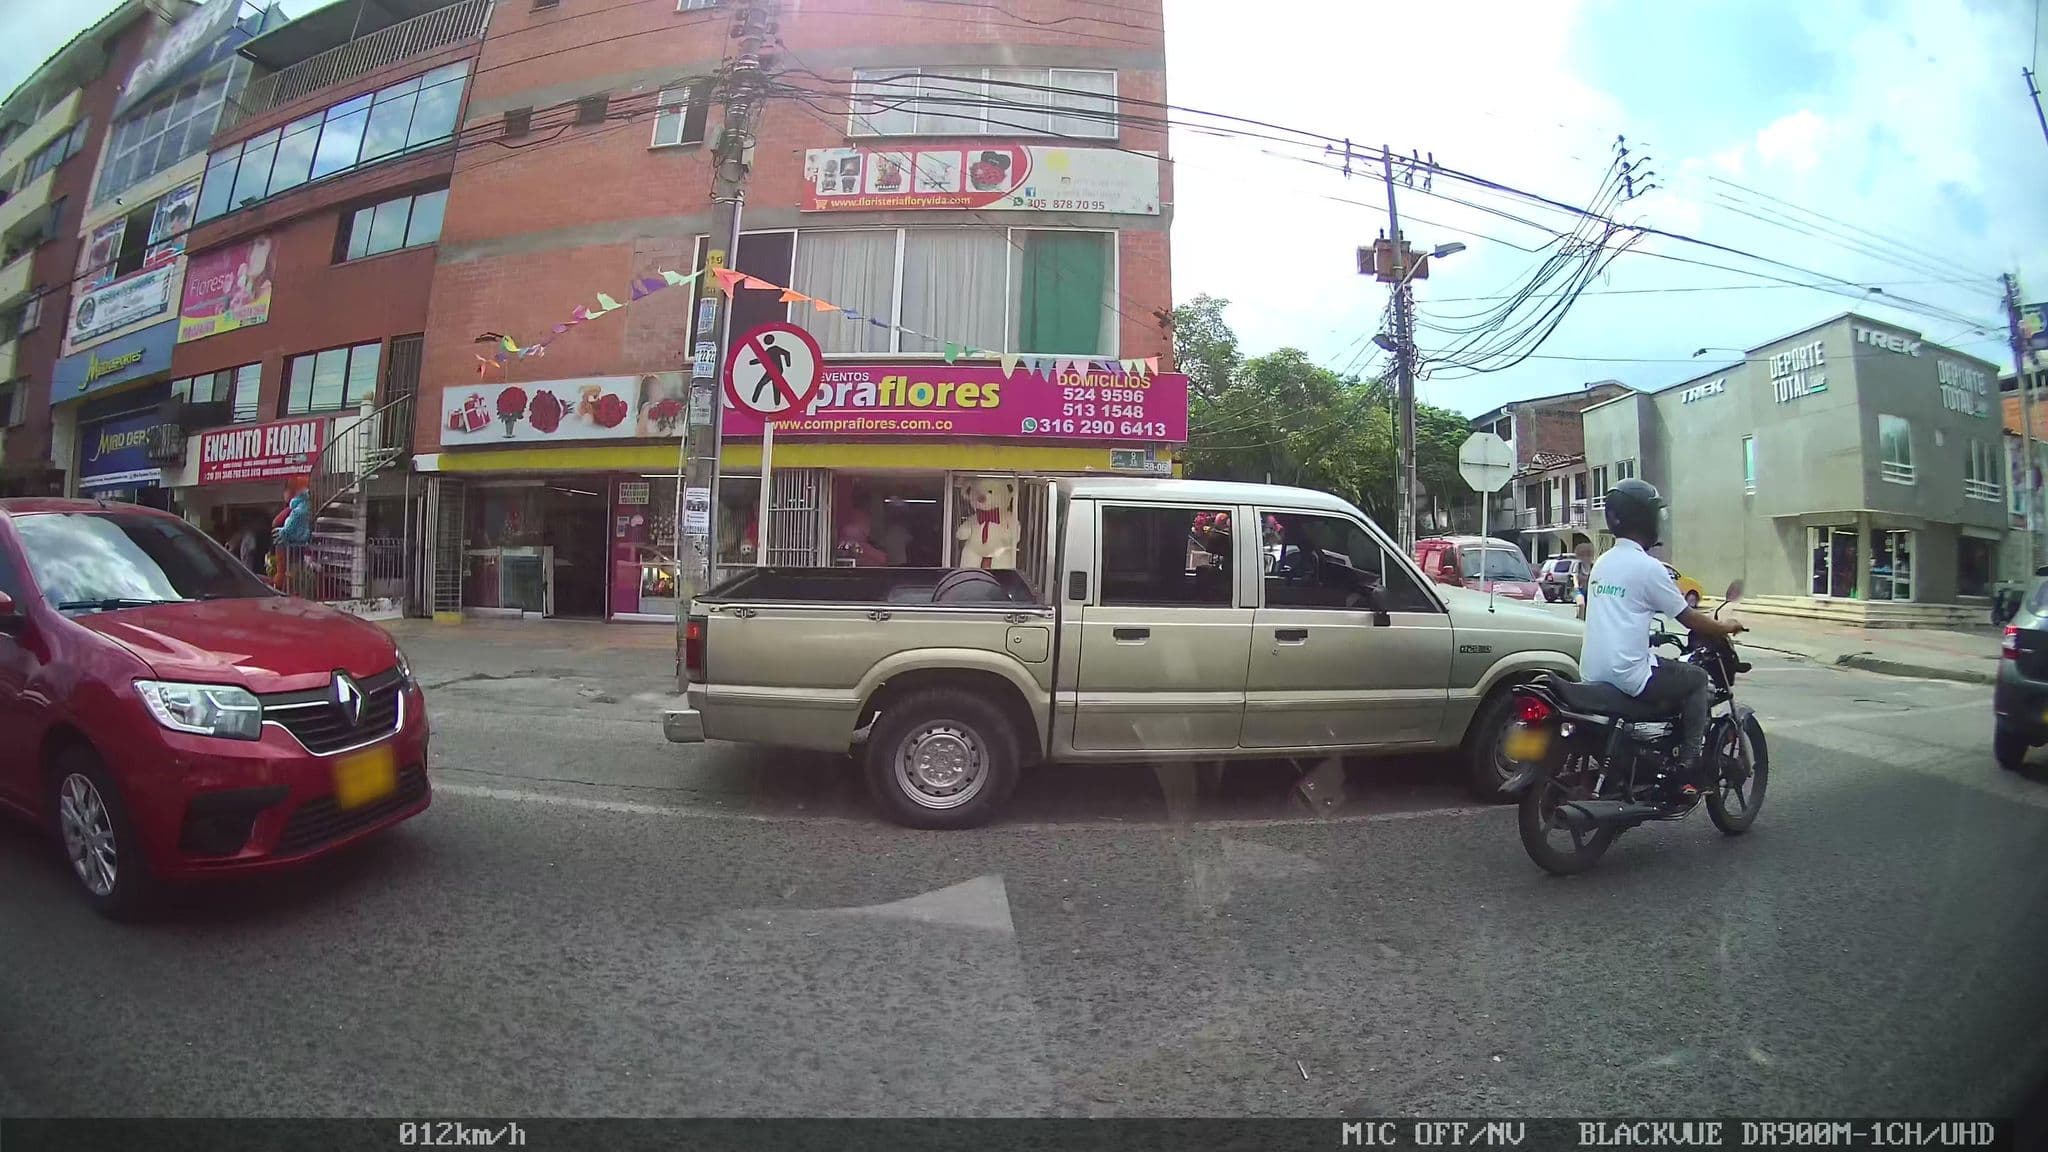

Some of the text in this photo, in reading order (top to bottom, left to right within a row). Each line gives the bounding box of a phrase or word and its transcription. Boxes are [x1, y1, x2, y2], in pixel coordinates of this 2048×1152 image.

[831, 196, 971, 209] www.floristeriafloryvida.com
[1053, 200, 1073, 209] 878
[1077, 200, 1089, 209] 70
[1092, 201, 1105, 210] 95
[1853, 326, 1921, 357] TREK
[1769, 341, 1824, 379] DEPORTE
[1057, 374, 1151, 389] DOMICILIOS
[1681, 378, 1725, 403] TREK
[1772, 371, 1809, 403] TOTAL
[806, 375, 1000, 416] praflores
[1063, 388, 1144, 403] 524 9596
[1063, 403, 1144, 418] 513 1548
[772, 417, 953, 432] www.compraflores.com.co
[1040, 418, 1166, 436] 316 290 6413
[204, 422, 318, 463] ENCANTO FLORAL
